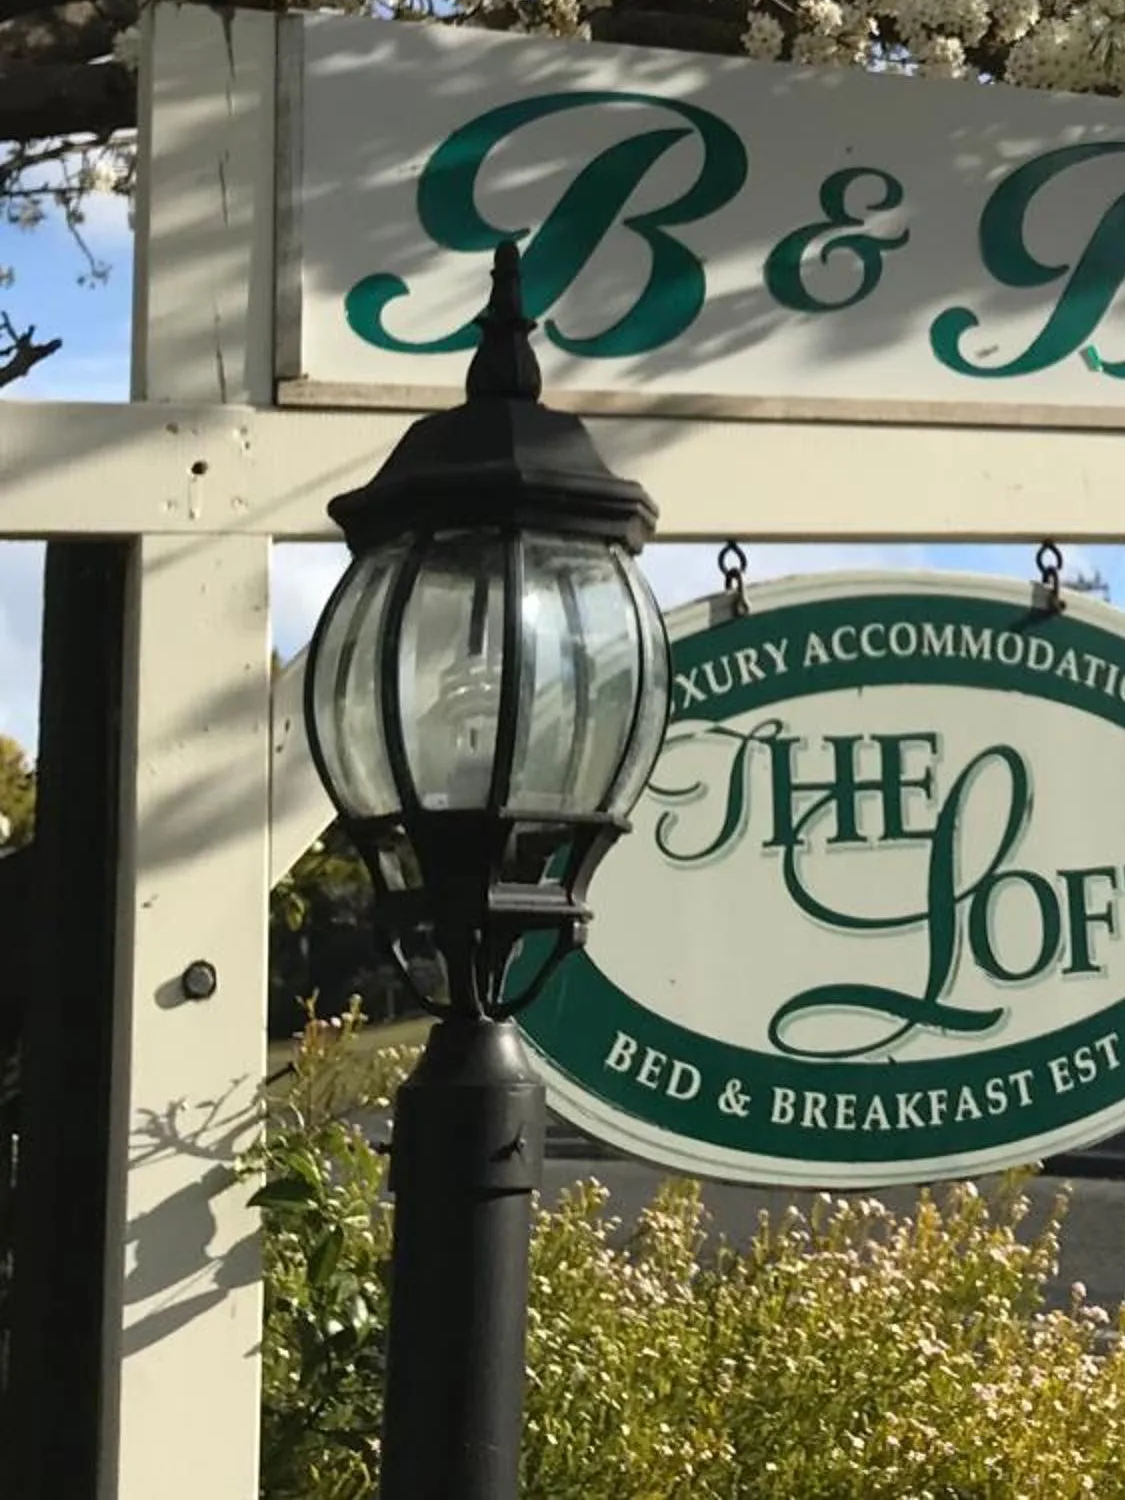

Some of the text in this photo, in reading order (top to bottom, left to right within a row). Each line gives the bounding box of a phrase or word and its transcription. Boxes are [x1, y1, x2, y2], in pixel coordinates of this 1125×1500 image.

[344, 90, 749, 358] B
[763, 166, 911, 313] &
[670, 637, 789, 713] XURY
[647, 717, 940, 864] THE
[604, 1031, 702, 1102] BED
[717, 1079, 751, 1117] &
[770, 1070, 1035, 1132] BREAKFAST
